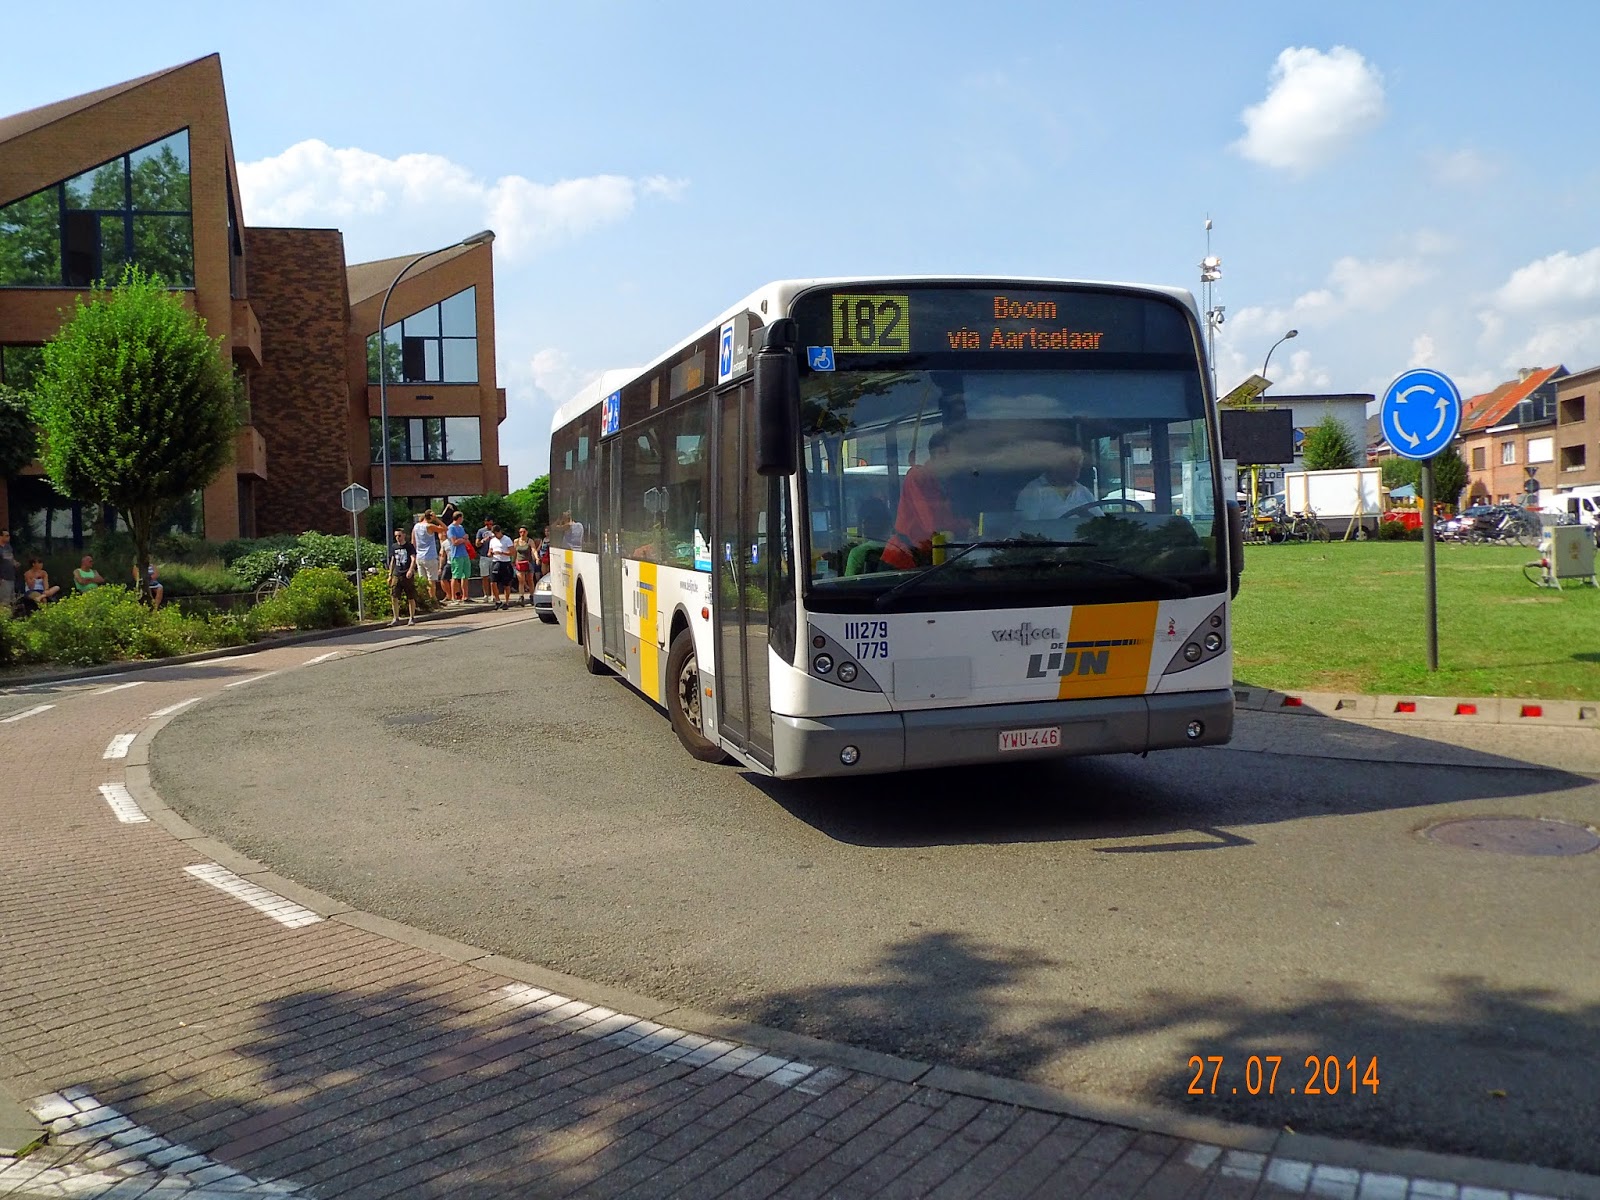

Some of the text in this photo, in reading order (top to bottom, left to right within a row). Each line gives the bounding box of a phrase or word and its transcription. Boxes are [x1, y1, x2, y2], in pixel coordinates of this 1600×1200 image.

[994, 296, 1057, 319] Boom
[838, 300, 902, 347] 182
[948, 327, 1104, 350] via Aartselaar
[845, 621, 888, 640] 111279
[856, 641, 888, 660] 1779
[1050, 642, 1064, 650] DE
[1026, 650, 1110, 679] LIJN
[1002, 729, 1058, 748] YWU-446
